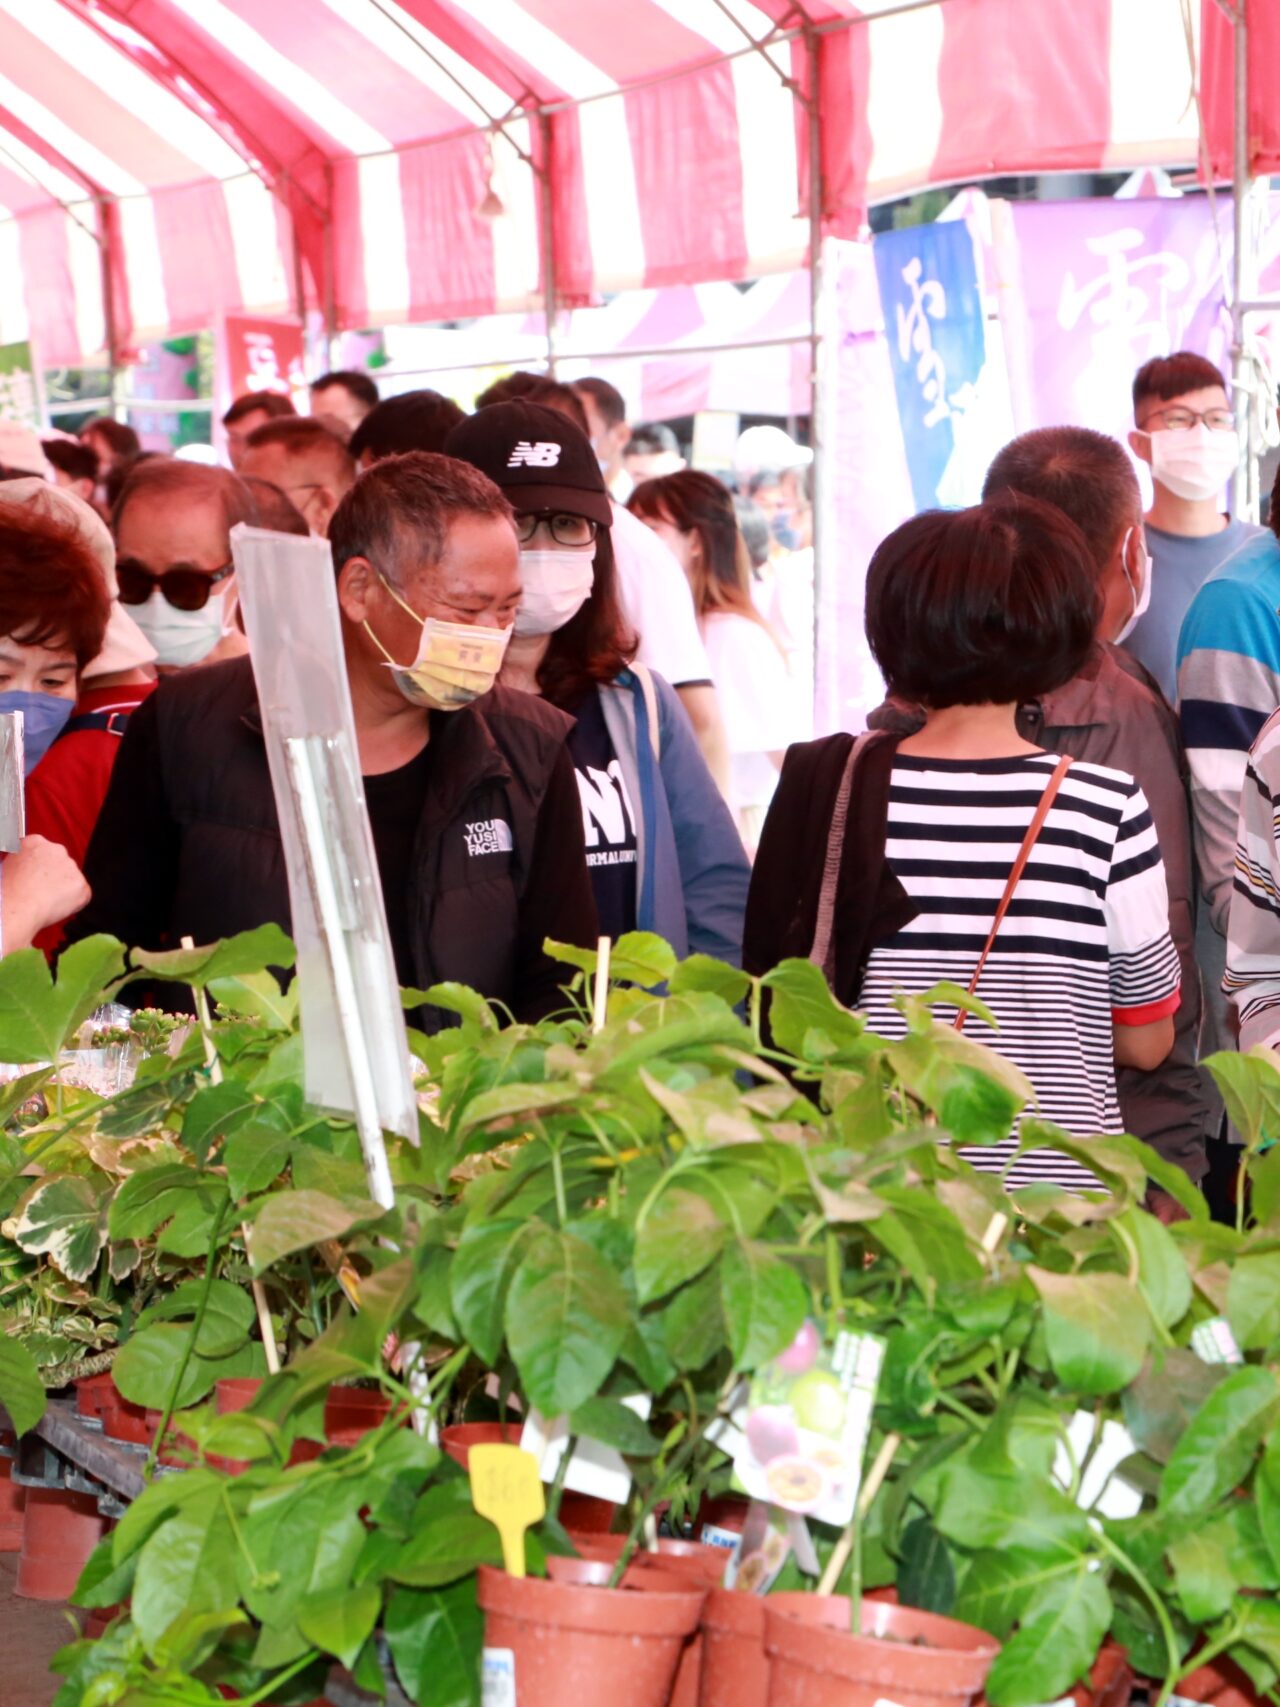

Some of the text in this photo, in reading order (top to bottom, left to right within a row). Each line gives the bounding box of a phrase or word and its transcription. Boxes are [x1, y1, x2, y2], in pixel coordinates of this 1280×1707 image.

[465, 819, 495, 834] YOU
[463, 830, 497, 845] YUSI
[468, 841, 500, 857] FACE
